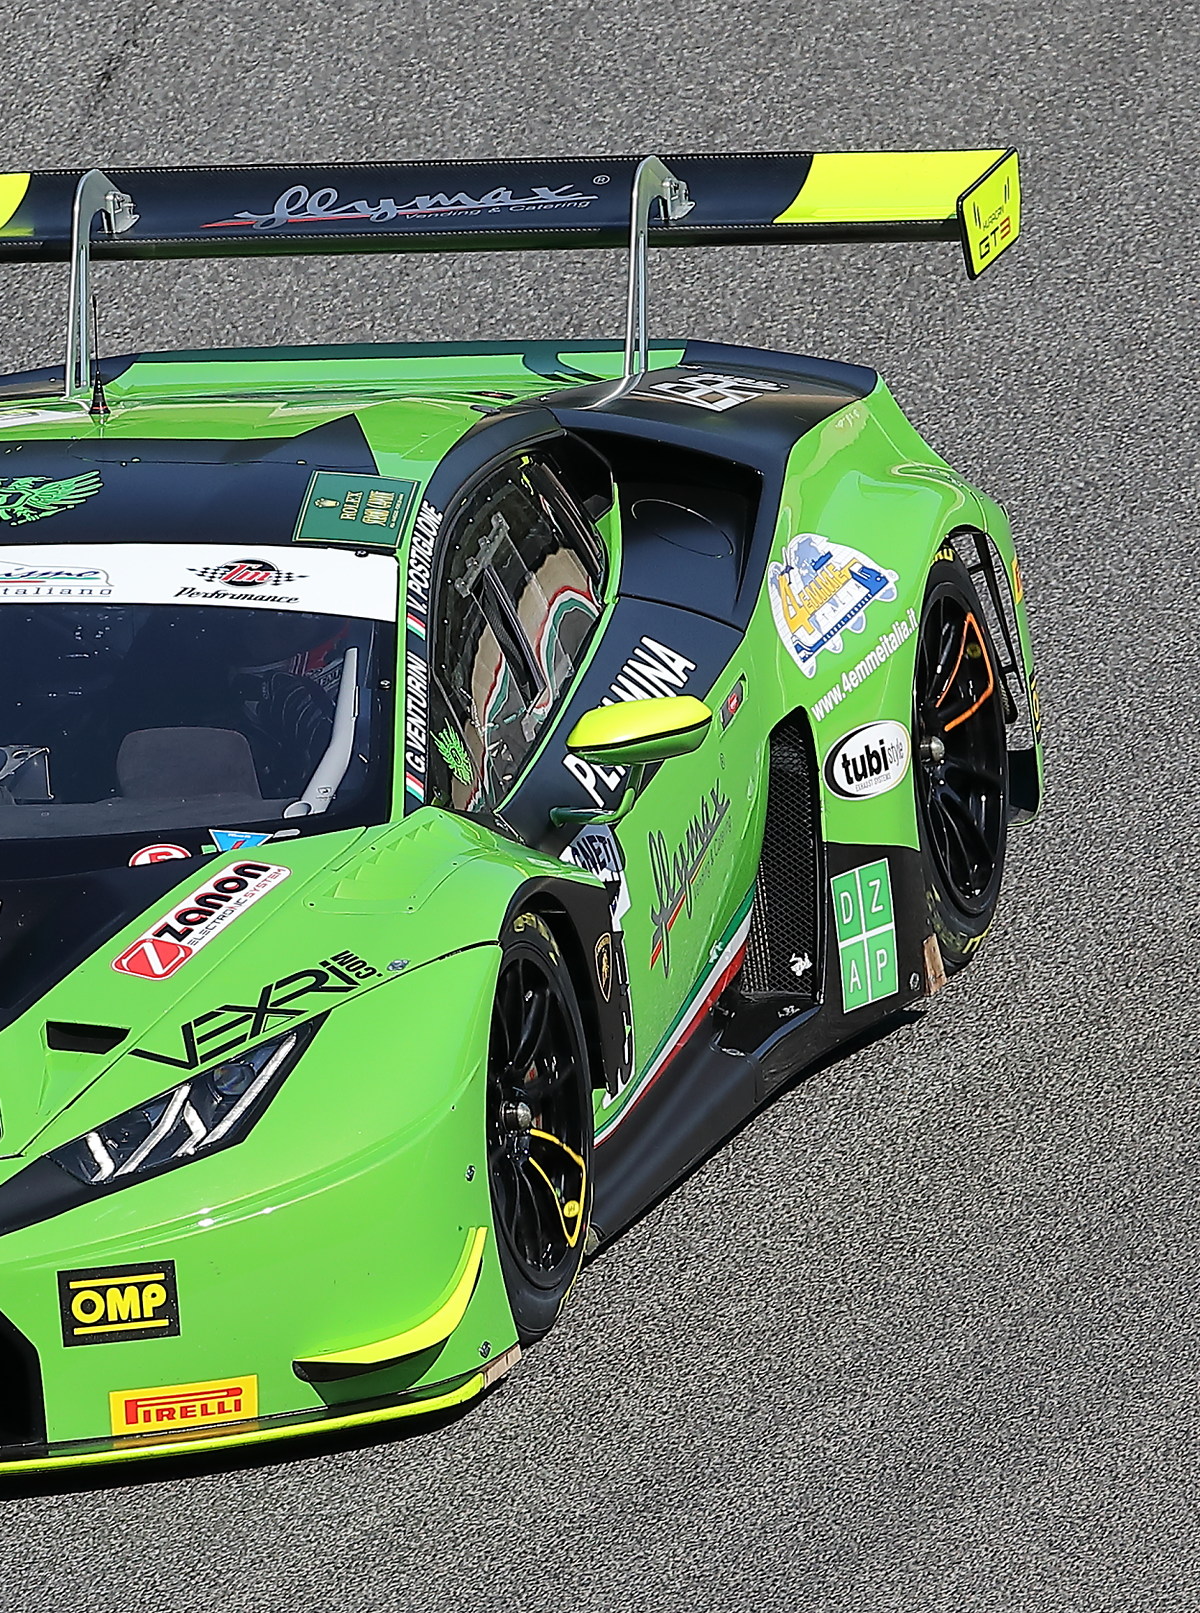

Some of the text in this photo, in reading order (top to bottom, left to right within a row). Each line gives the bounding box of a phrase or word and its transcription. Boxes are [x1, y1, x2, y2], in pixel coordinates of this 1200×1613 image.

[405, 208, 481, 219] Vending
[509, 199, 591, 212] Catering
[979, 216, 1011, 260] GT3
[340, 490, 363, 520] ROLEX
[406, 500, 443, 615] V. POSTIGLIONE
[173, 587, 300, 604] Performance
[811, 608, 919, 722] www.4emmeitalia.it
[405, 651, 427, 774] G. VENTURINI
[841, 737, 904, 785] tubi style
[152, 863, 272, 942] zanon
[243, 868, 287, 898] SYSTEM
[71, 1283, 167, 1324] OMP
[125, 1387, 243, 1425] PIRELLI
